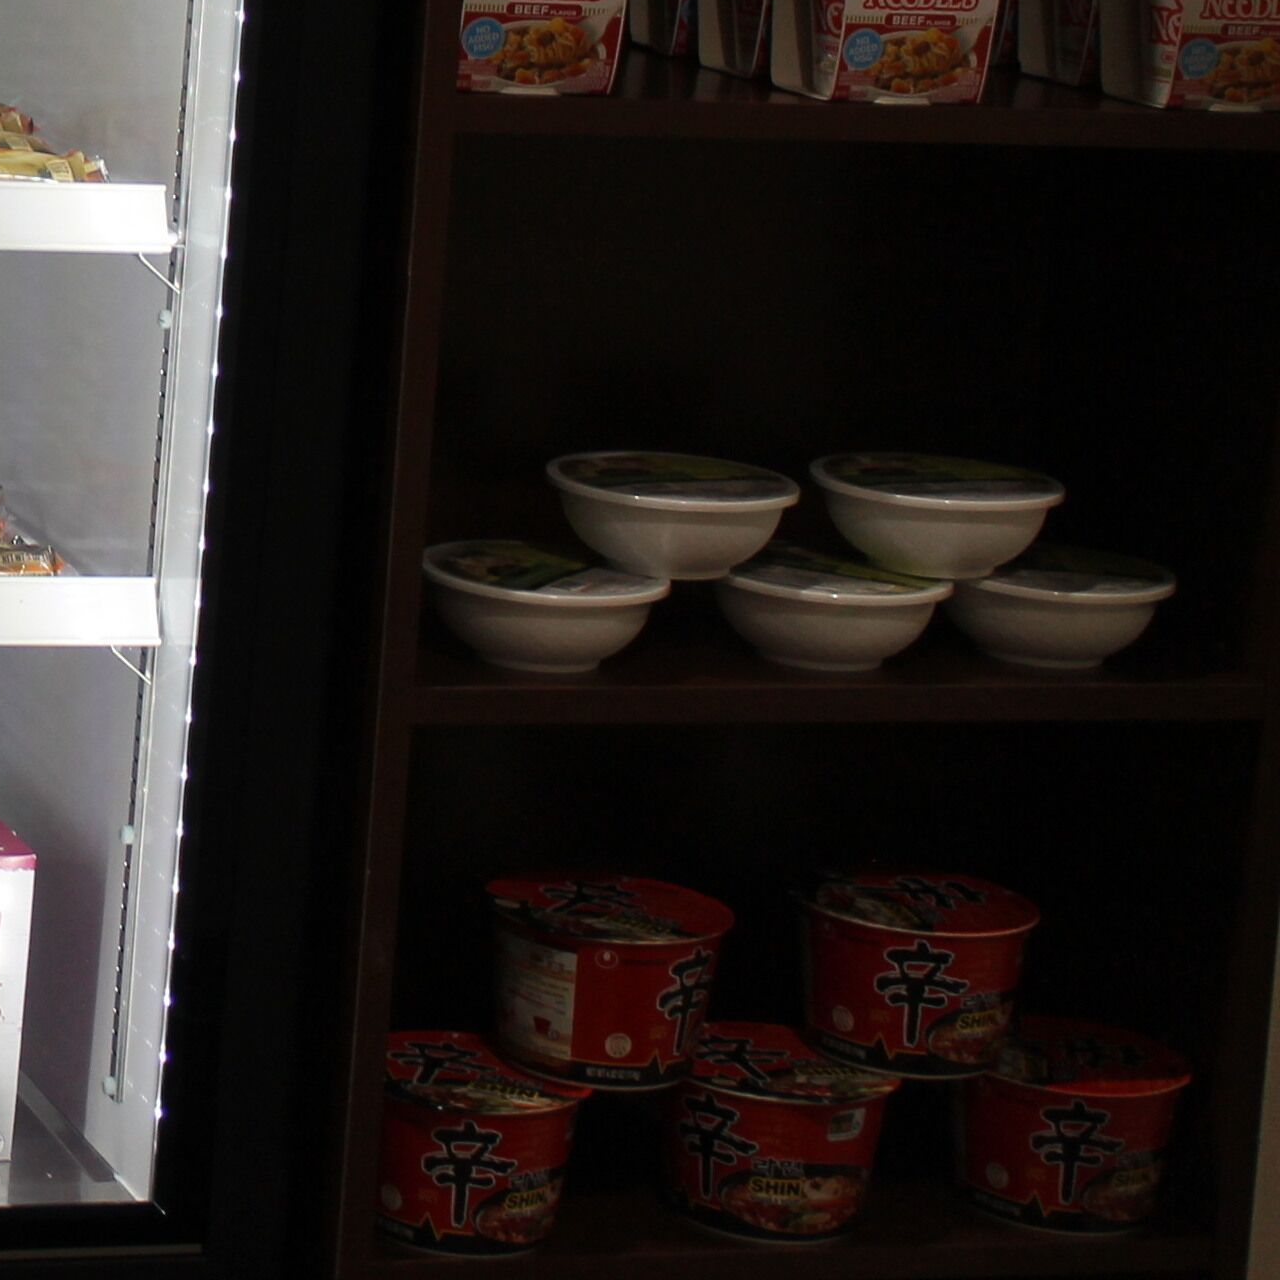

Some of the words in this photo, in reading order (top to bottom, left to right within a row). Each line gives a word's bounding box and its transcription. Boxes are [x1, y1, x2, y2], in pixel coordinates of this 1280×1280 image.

[514, 4, 550, 15] BEEF
[892, 15, 925, 25] BEEF
[874, 938, 970, 1048] 辛
[421, 1119, 518, 1228] 辛
[1029, 1098, 1125, 1205] 辛
[751, 1178, 799, 1196] SHIN
